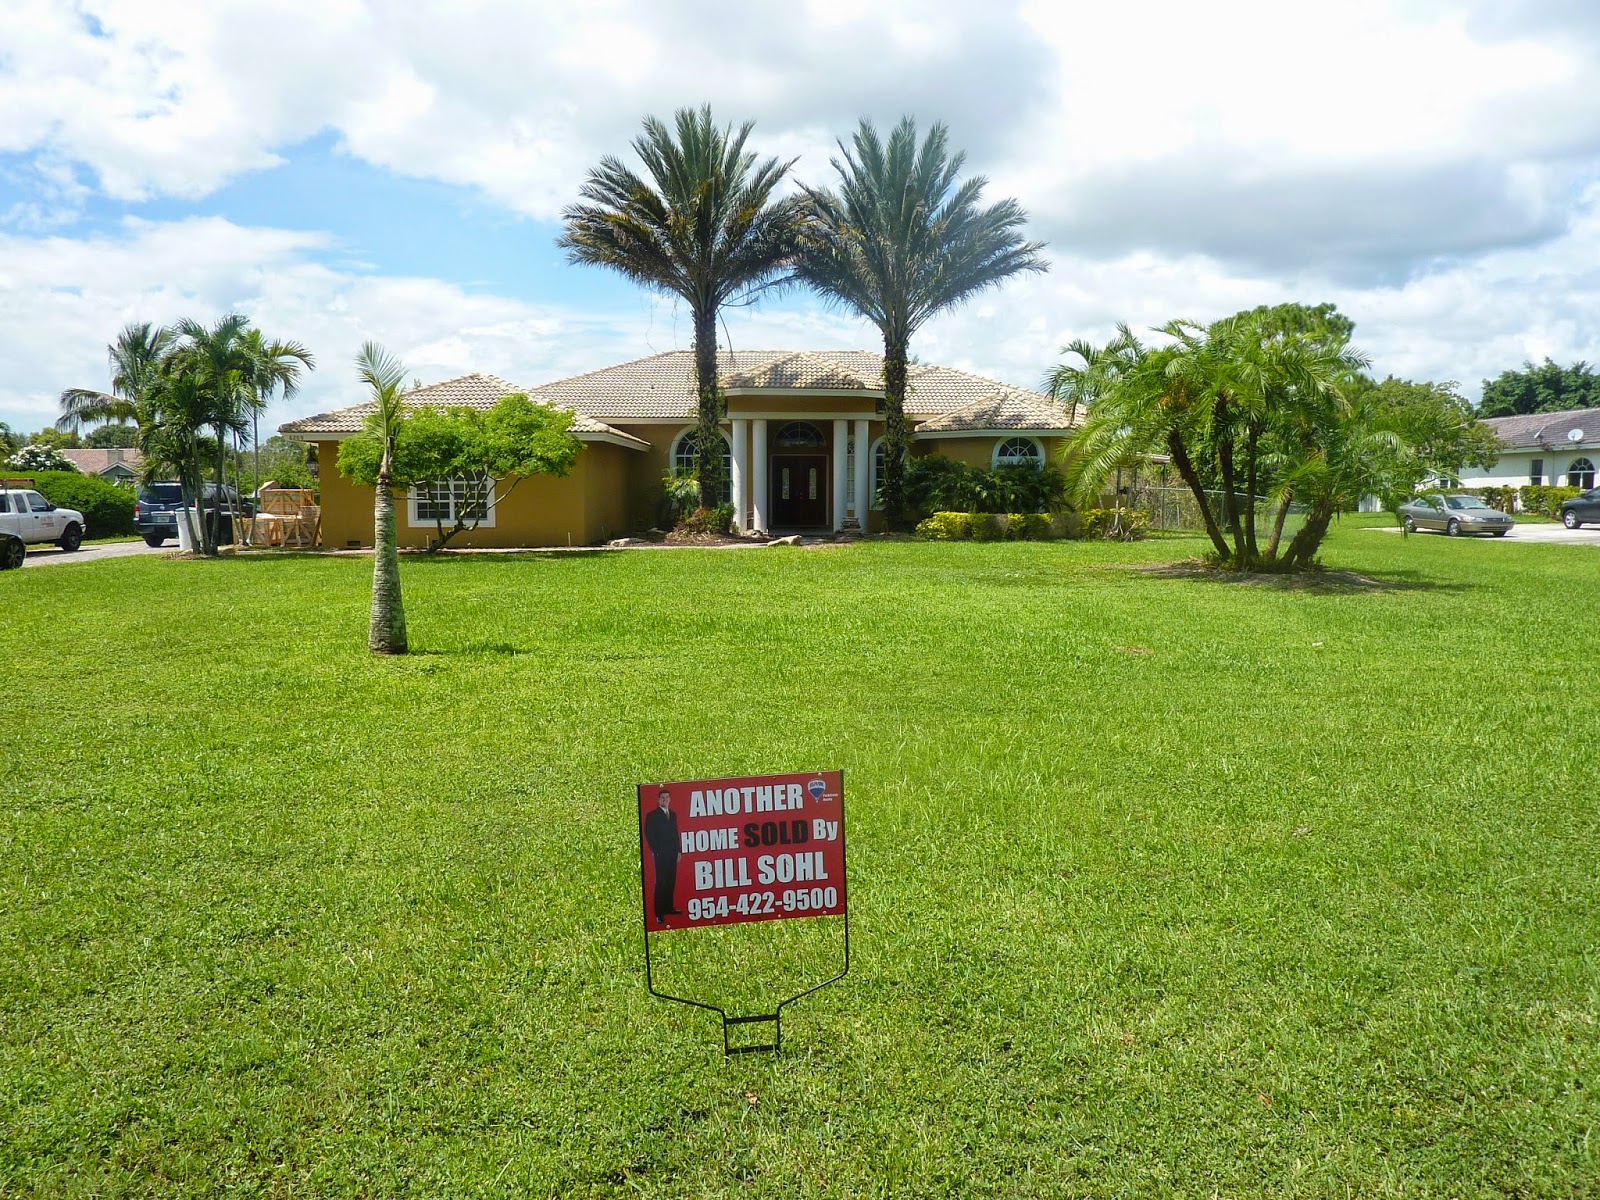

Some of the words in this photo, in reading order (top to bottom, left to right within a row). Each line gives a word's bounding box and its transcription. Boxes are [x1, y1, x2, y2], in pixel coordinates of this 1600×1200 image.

[689, 783, 804, 818] ANOTHER
[681, 828, 739, 853] HOME
[744, 820, 808, 847] SOLD
[812, 818, 838, 841] By
[694, 857, 752, 890] BILL
[757, 851, 829, 885] SOHL
[687, 886, 838, 921] 954-422-9500
